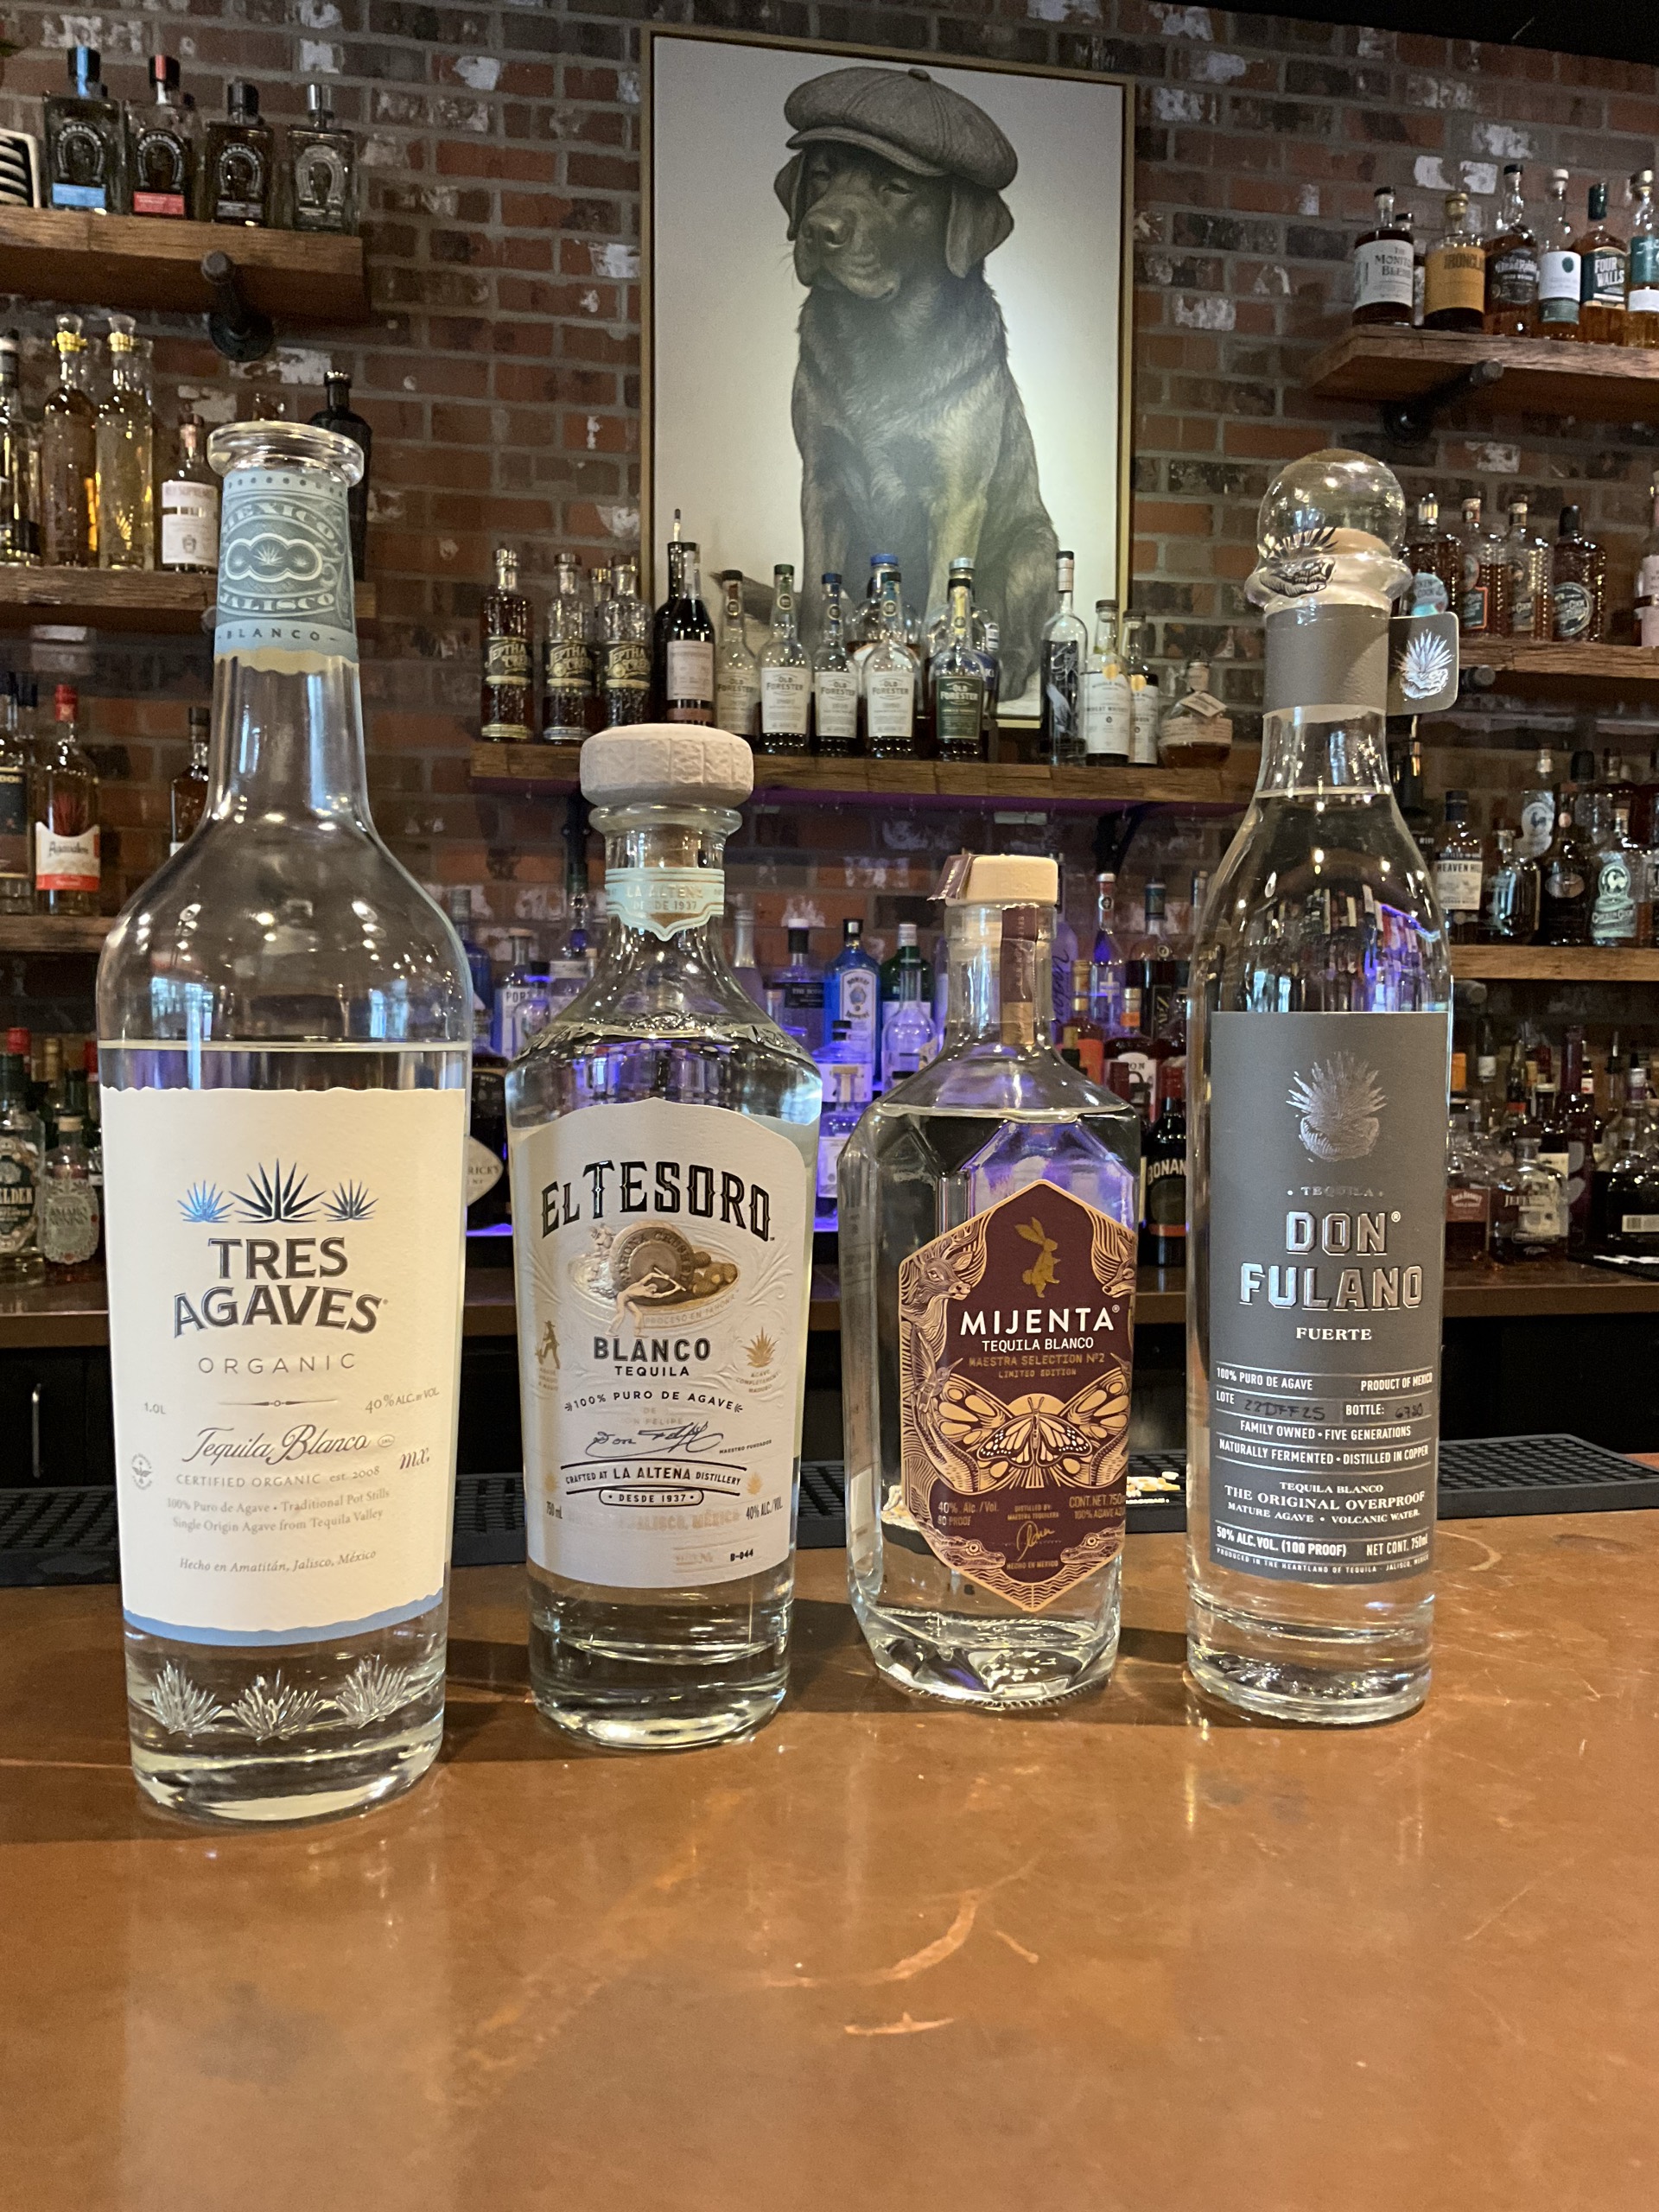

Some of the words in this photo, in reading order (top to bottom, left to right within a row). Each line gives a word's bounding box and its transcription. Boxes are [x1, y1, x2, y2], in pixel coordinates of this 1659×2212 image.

[1594, 257, 1618, 274] FOUR
[1597, 270, 1624, 287] WALLS
[219, 593, 334, 612] JALISCO
[226, 627, 321, 640] BLANCO
[626, 884, 642, 898] LA
[674, 901, 697, 910] 1937
[1300, 1185, 1374, 1196] TEQUILA
[541, 1180, 581, 1239] EL
[582, 1160, 771, 1243] TESORO
[1286, 1211, 1388, 1256] DON
[207, 1236, 348, 1281] TRES
[654, 1231, 690, 1284] CRUSHED
[1239, 1262, 1423, 1312] FULANO
[174, 1284, 383, 1338] AGAVES
[645, 1313, 688, 1325] PROCESO
[691, 1312, 702, 1320] EN
[960, 1306, 1115, 1336] MIJENTA
[1295, 1327, 1372, 1340] FUERTE
[593, 1336, 711, 1363] BLANCO
[982, 1339, 1040, 1353] TEQUILA
[1045, 1337, 1094, 1351] BLANCO
[198, 1353, 356, 1375] ORGANIC
[614, 1365, 690, 1377] TEQUILA
[969, 1357, 1017, 1367] MAESTRA
[1021, 1354, 1084, 1366] SELECTION
[998, 1370, 1036, 1379] LIMITED
[1040, 1370, 1077, 1378] EDITION
[1217, 1367, 1237, 1382] 100%
[1239, 1371, 1263, 1386] PURO
[1266, 1375, 1278, 1387] DE
[1281, 1376, 1313, 1391] AGAVE
[1360, 1377, 1400, 1391] PRODUCT
[1402, 1376, 1411, 1389] OF
[1412, 1372, 1433, 1387] MEXICO
[143, 1402, 167, 1415] 1.0L
[365, 1393, 395, 1414] 40%
[396, 1393, 415, 1406] ALC.
[573, 1394, 607, 1409] 100%
[613, 1391, 652, 1401] PURO
[661, 1390, 680, 1401] DE
[688, 1393, 734, 1410] AGAVE
[1216, 1390, 1235, 1405] LOTE
[1345, 1403, 1385, 1416] BOTTLE:
[1240, 1420, 1274, 1436] FAMILY
[1276, 1426, 1315, 1440] OWNED
[1325, 1427, 1348, 1441] FIVE
[1351, 1426, 1412, 1440] GENERATIONS
[181, 1427, 274, 1466] Tequila
[265, 1424, 371, 1465] Blanco
[1219, 1438, 1268, 1459] NATURALLY
[1271, 1449, 1334, 1465] FERMENTED
[1343, 1450, 1390, 1465] DISTILLED
[1393, 1450, 1402, 1461] IN
[1404, 1445, 1428, 1460] COPPER
[175, 1474, 246, 1488] CERTIFIED
[251, 1473, 321, 1488] ORGANIC
[352, 1465, 380, 1479] 2008
[565, 1473, 596, 1485] CRAFTED
[599, 1471, 607, 1479] AT
[613, 1468, 631, 1479] LA
[696, 1471, 741, 1485] DISTILLERY
[619, 1493, 655, 1503] DESDE
[661, 1493, 686, 1503] 1937
[1224, 1484, 1253, 1501] THE
[1257, 1492, 1339, 1510] ORIGINAL
[1345, 1491, 1426, 1510] OVERPROOF
[1279, 1482, 1333, 1494] TEQUILA
[1337, 1484, 1384, 1494] BLANCO
[167, 1497, 191, 1510] 100%
[193, 1501, 217, 1512] Puro
[219, 1501, 234, 1513] de
[236, 1503, 270, 1516] Agave
[281, 1495, 344, 1512] Traditional
[346, 1494, 364, 1505] Pot
[365, 1488, 390, 1501] Stills
[746, 1505, 760, 1520] 40%
[938, 1501, 958, 1514] 40%
[172, 1517, 201, 1533] Single
[203, 1519, 238, 1535] Origin
[242, 1521, 276, 1535] Agave
[279, 1518, 306, 1531] from
[310, 1515, 352, 1530] Tequila
[353, 1507, 385, 1522] Valley
[949, 1516, 971, 1526] PROOF
[1227, 1502, 1271, 1518] MATURE
[1274, 1510, 1314, 1523] AGAVE
[1331, 1513, 1388, 1525] VOLCANIC
[1217, 1526, 1235, 1541] 50%
[1236, 1531, 1256, 1548] ALC.
[1256, 1536, 1279, 1552] VOL.
[1281, 1540, 1306, 1555] (100
[1307, 1542, 1347, 1558] PROOF)
[1366, 1543, 1383, 1557] NET
[1386, 1539, 1409, 1554] CONT.
[179, 1556, 211, 1571] Hecho
[213, 1561, 227, 1573] en
[229, 1560, 290, 1573] Amatitán,
[292, 1558, 335, 1573] Jalisco,
[337, 1549, 377, 1567] México
[1217, 1547, 1249, 1563] PRODUCED
[1264, 1560, 1278, 1569] THE
[1282, 1562, 1329, 1573] HEARTLAND
[1345, 1565, 1377, 1573] TEQUILA
